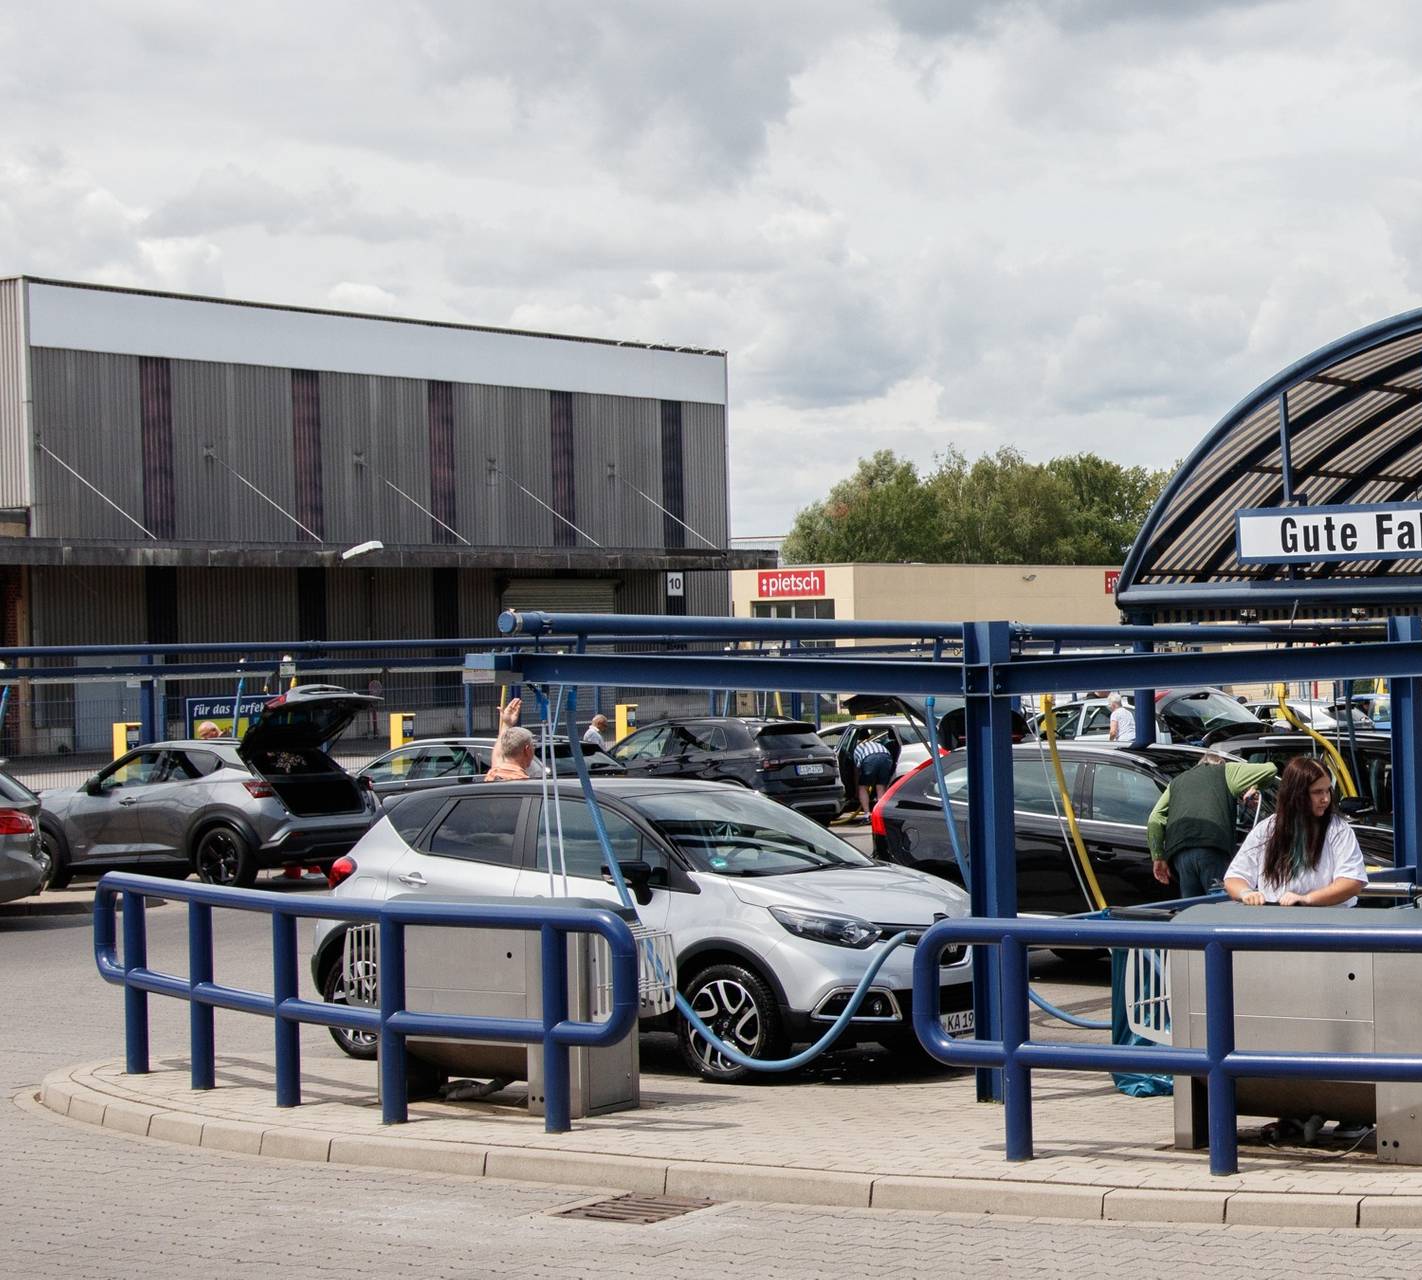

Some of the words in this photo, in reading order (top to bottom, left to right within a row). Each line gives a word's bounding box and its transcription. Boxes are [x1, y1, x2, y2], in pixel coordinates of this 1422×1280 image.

[1280, 517, 1358, 553] Gute
[668, 578, 681, 590] 10
[193, 703, 211, 717] für
[212, 704, 231, 714] das
